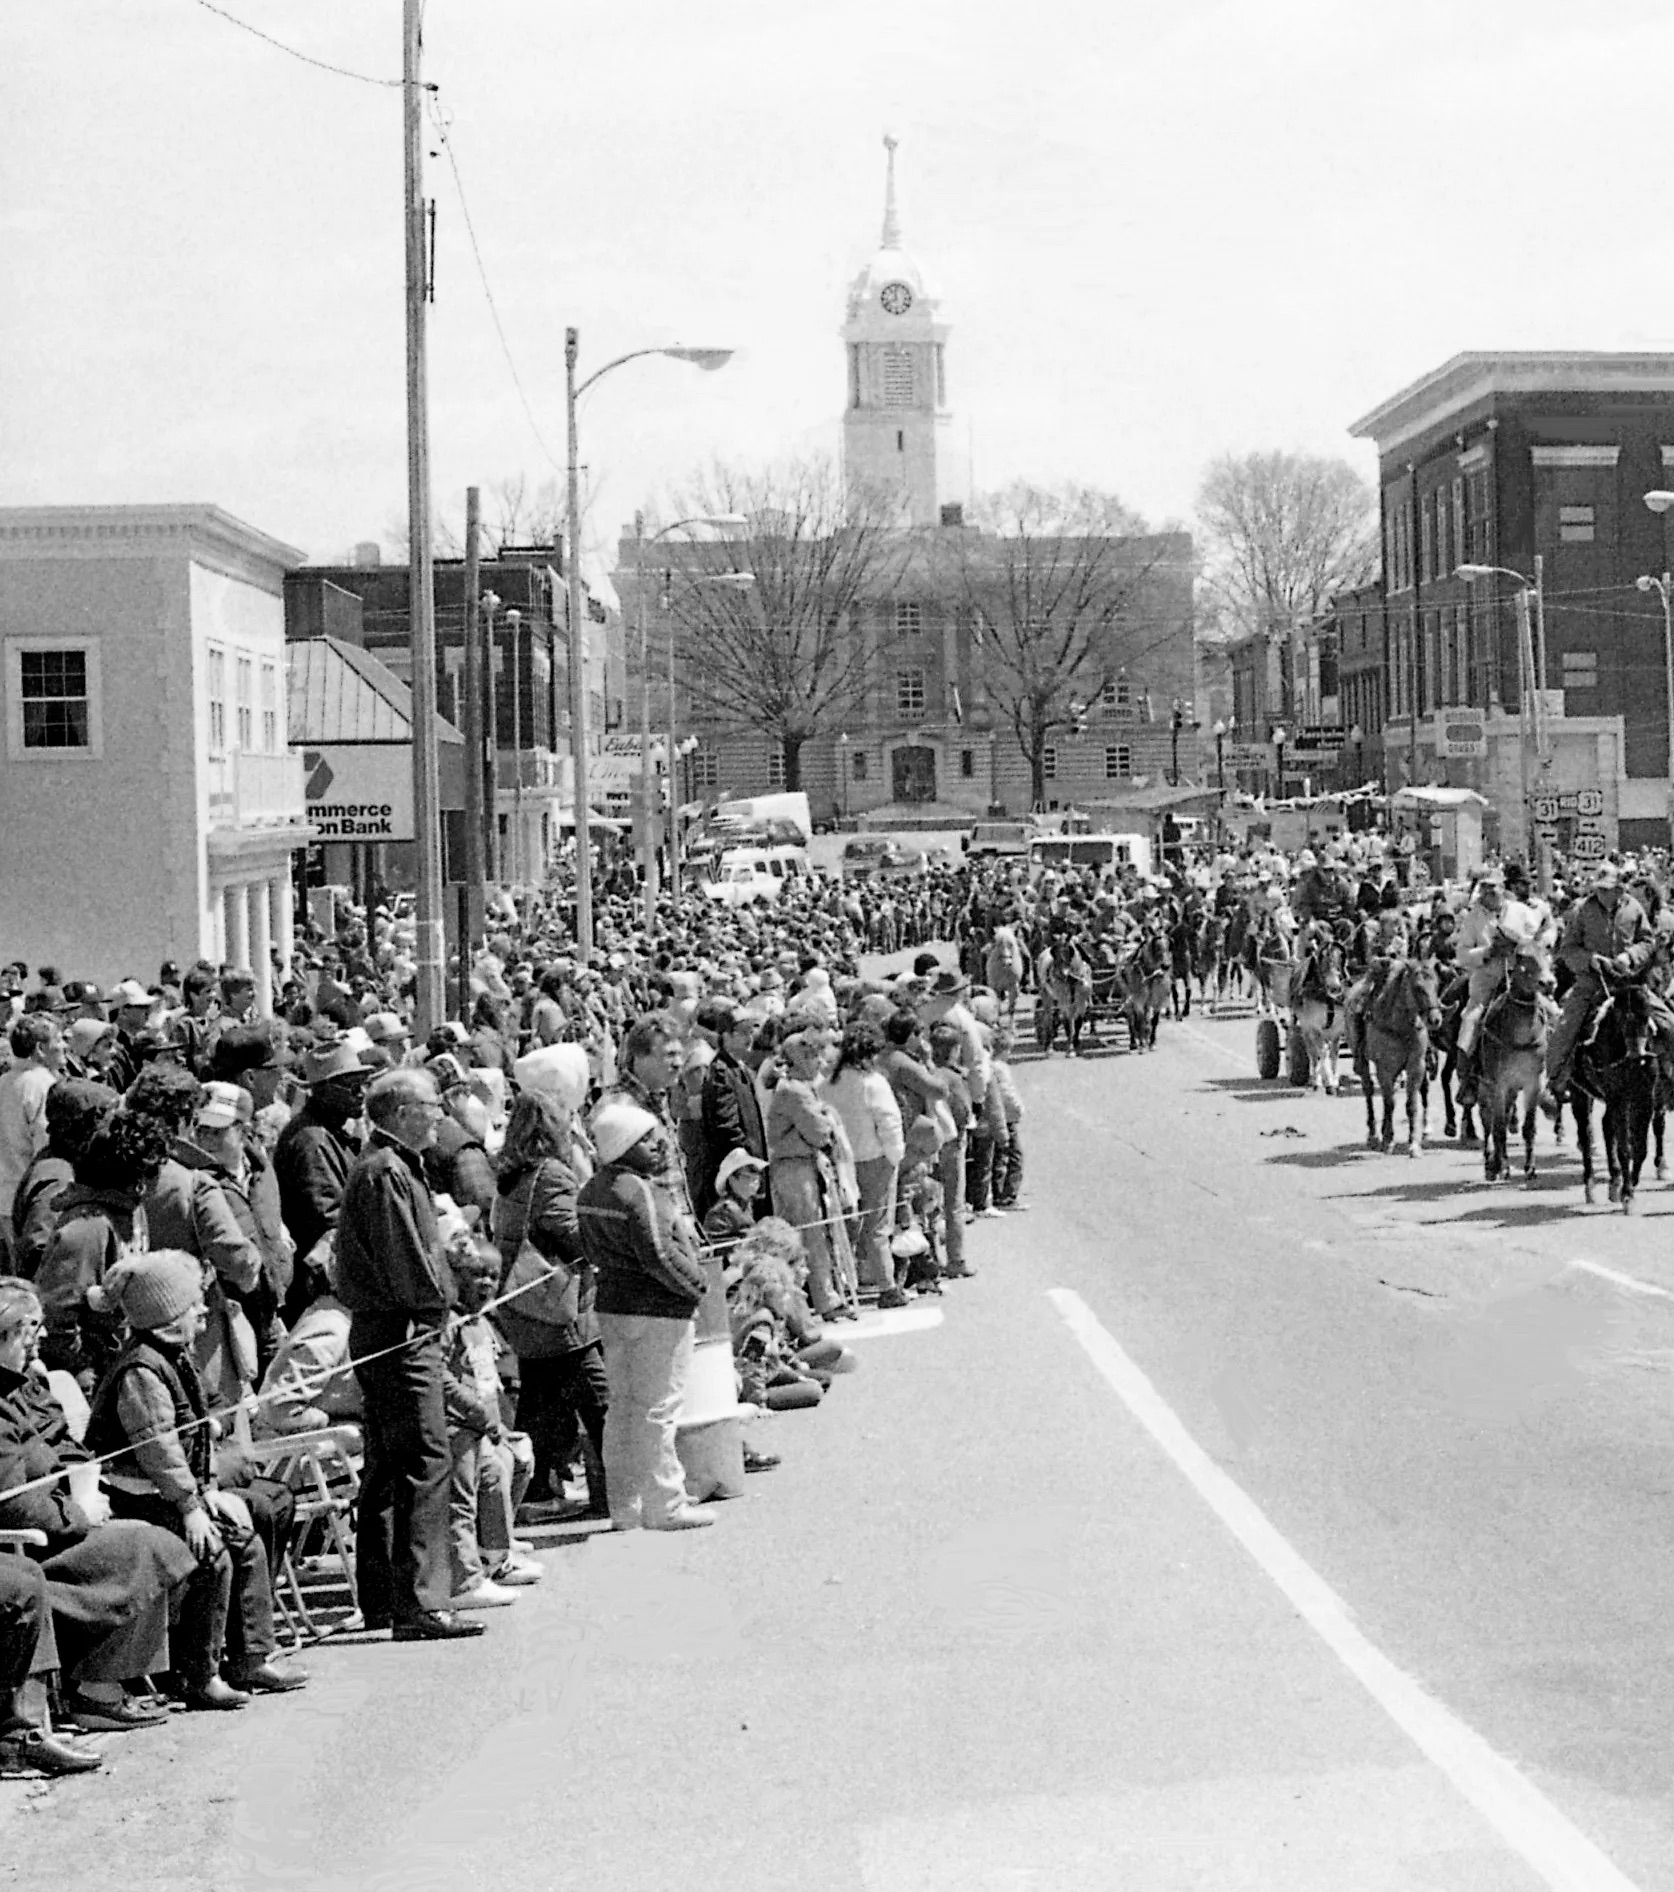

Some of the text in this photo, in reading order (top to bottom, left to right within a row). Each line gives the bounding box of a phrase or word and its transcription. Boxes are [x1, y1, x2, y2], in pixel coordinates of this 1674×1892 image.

[1584, 795, 1598, 809] 31
[306, 804, 392, 817] mmerce
[1540, 802, 1555, 817] 31
[340, 818, 392, 834] Bank
[1577, 840, 1602, 853] 412
